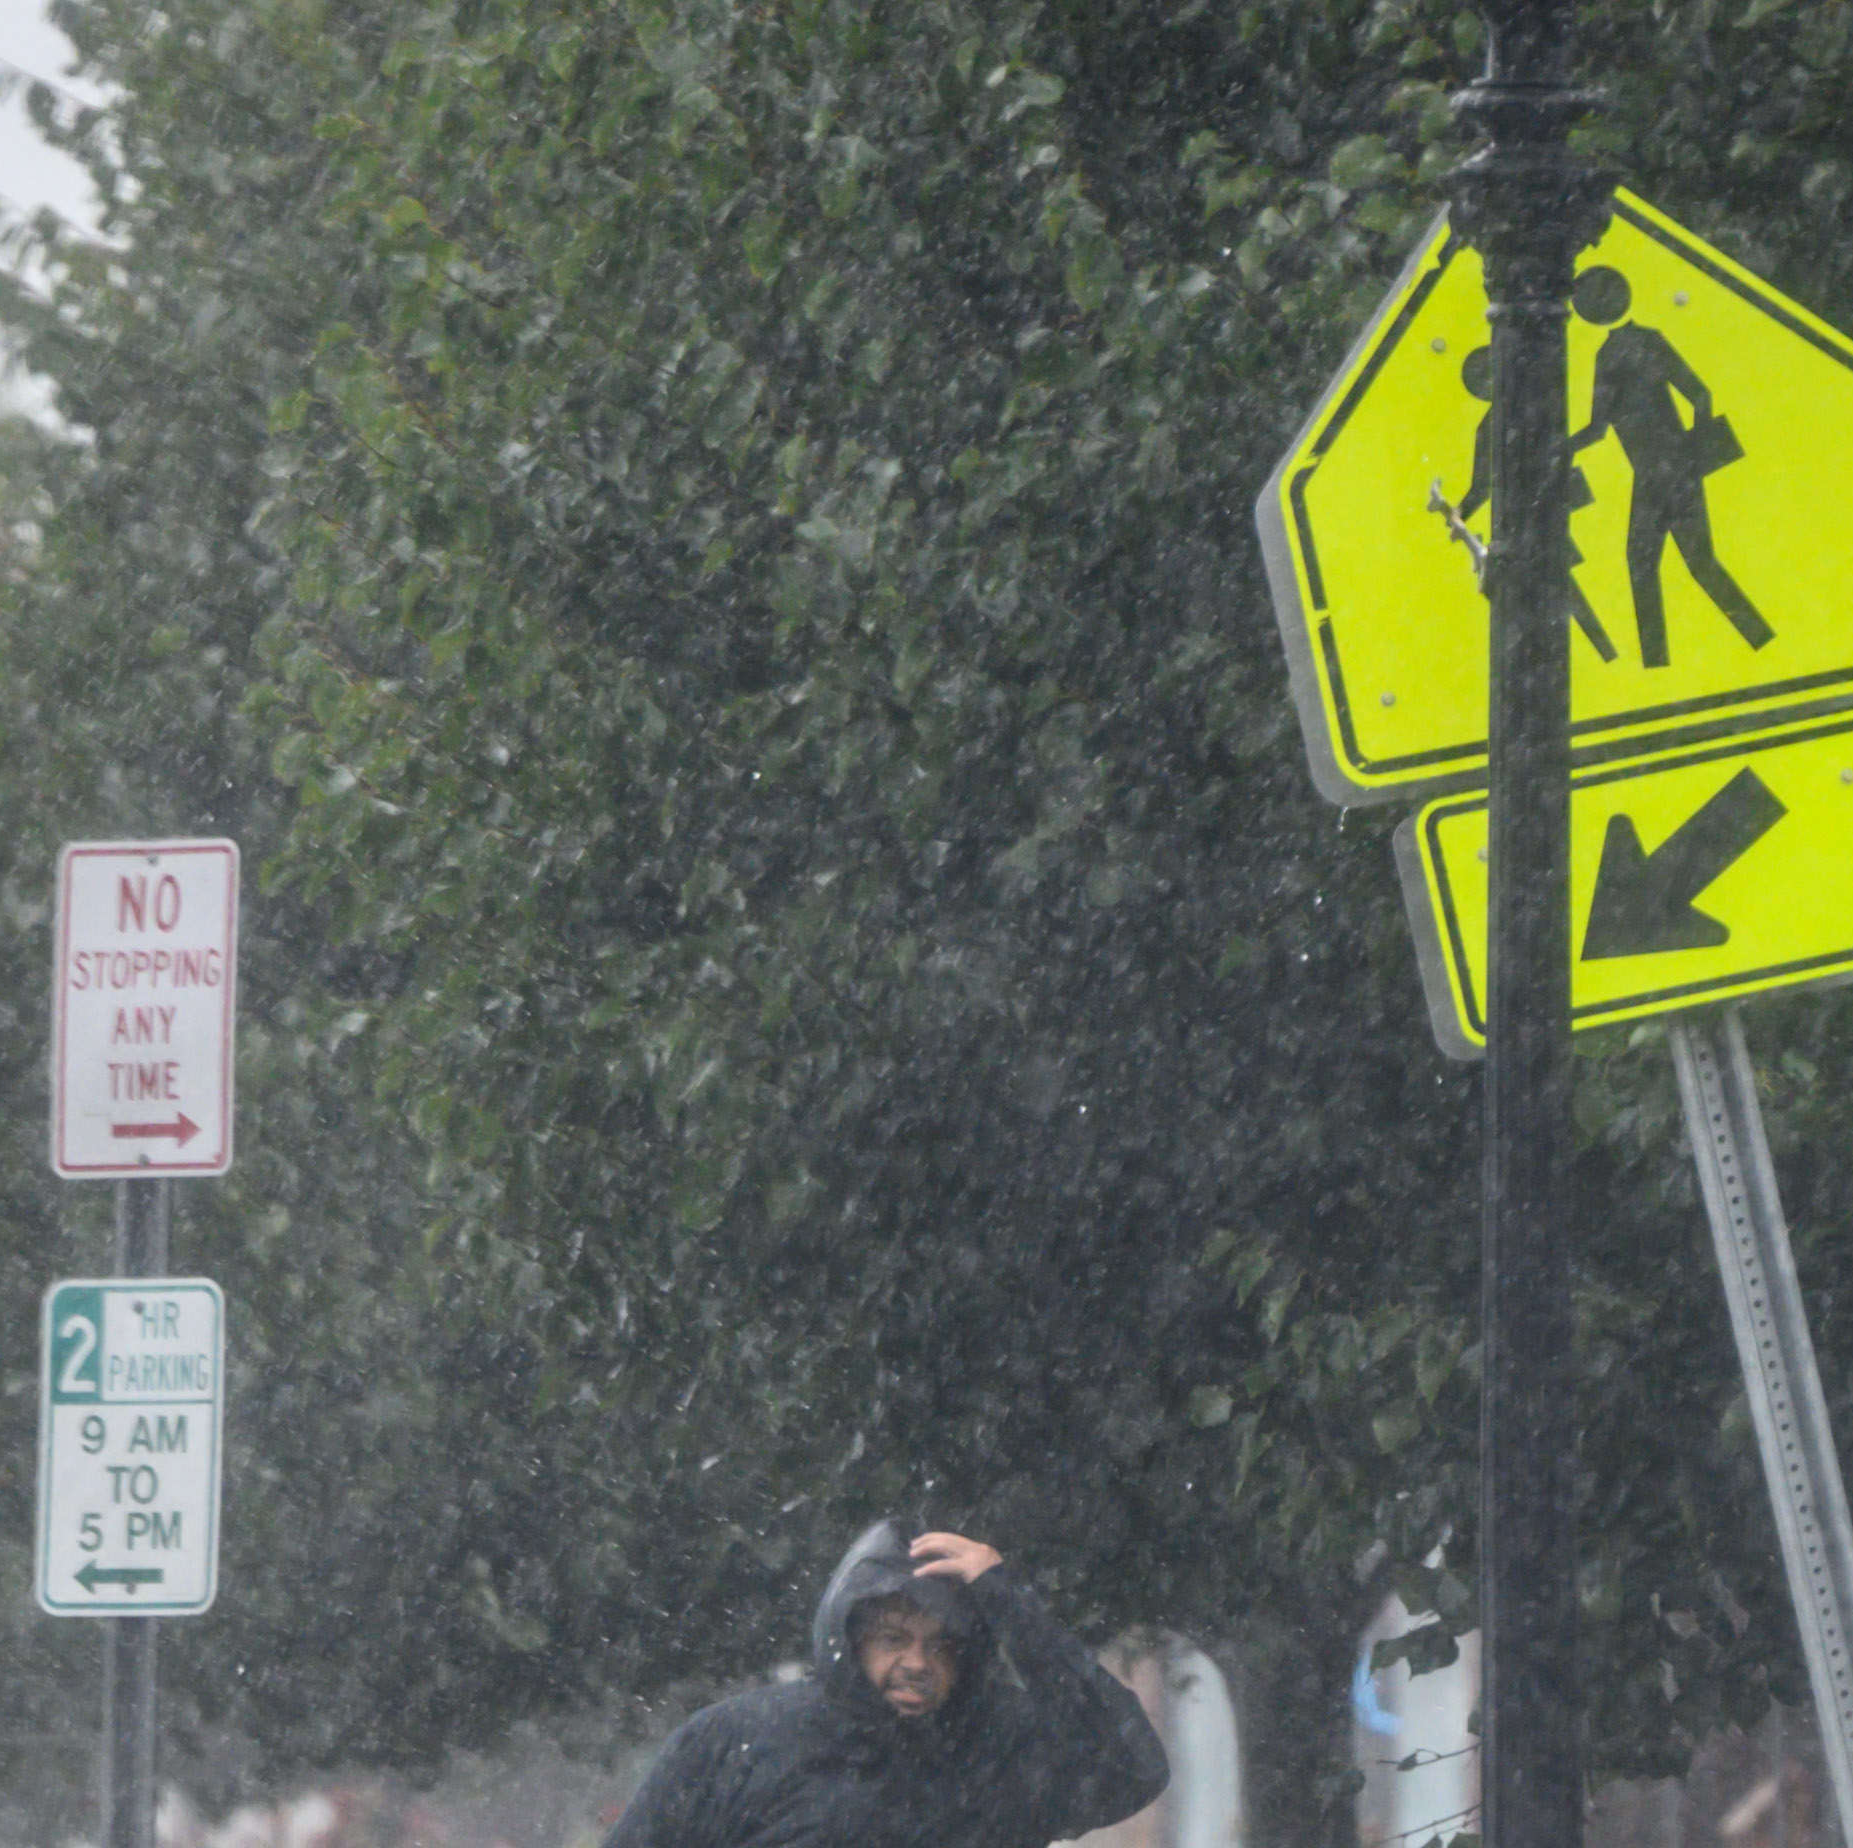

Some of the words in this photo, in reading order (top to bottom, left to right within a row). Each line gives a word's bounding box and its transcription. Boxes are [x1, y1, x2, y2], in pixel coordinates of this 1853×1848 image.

[118, 874, 180, 934] NO
[69, 948, 222, 991] STOPPING
[111, 1006, 177, 1045] ANY
[108, 1062, 181, 1102] TIME
[138, 1301, 180, 1340] HR
[59, 1317, 98, 1394] 2
[108, 1353, 210, 1393] PARKING
[80, 1415, 106, 1455] 9
[127, 1415, 188, 1455] AM
[108, 1467, 160, 1505] TO
[78, 1512, 103, 1552] 5
[126, 1510, 182, 1550] PM
